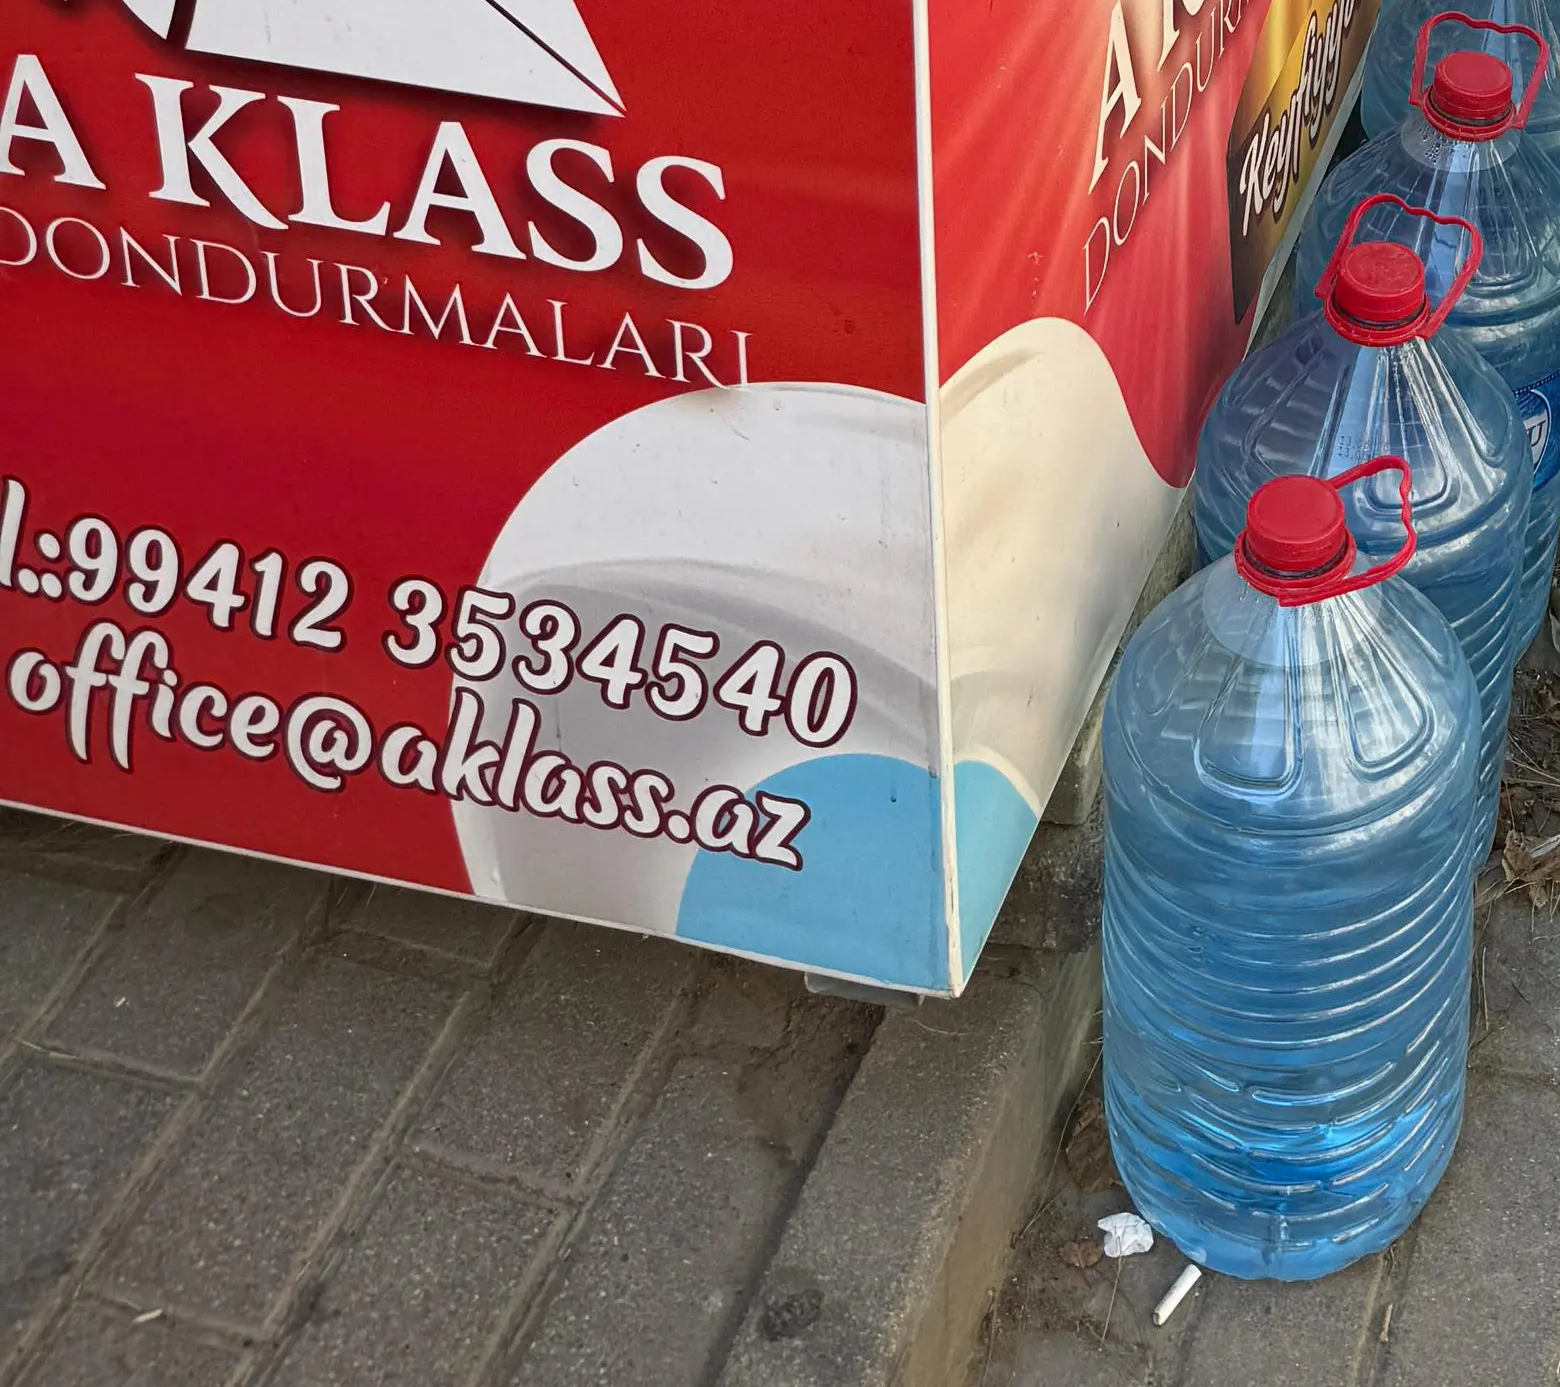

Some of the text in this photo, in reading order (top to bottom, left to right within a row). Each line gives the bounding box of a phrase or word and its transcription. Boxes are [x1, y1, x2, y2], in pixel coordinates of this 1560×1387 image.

[0, 53, 735, 290] A KLASS
[6, 620, 811, 872] office@aklass.az
[383, 574, 858, 749] 3534540
